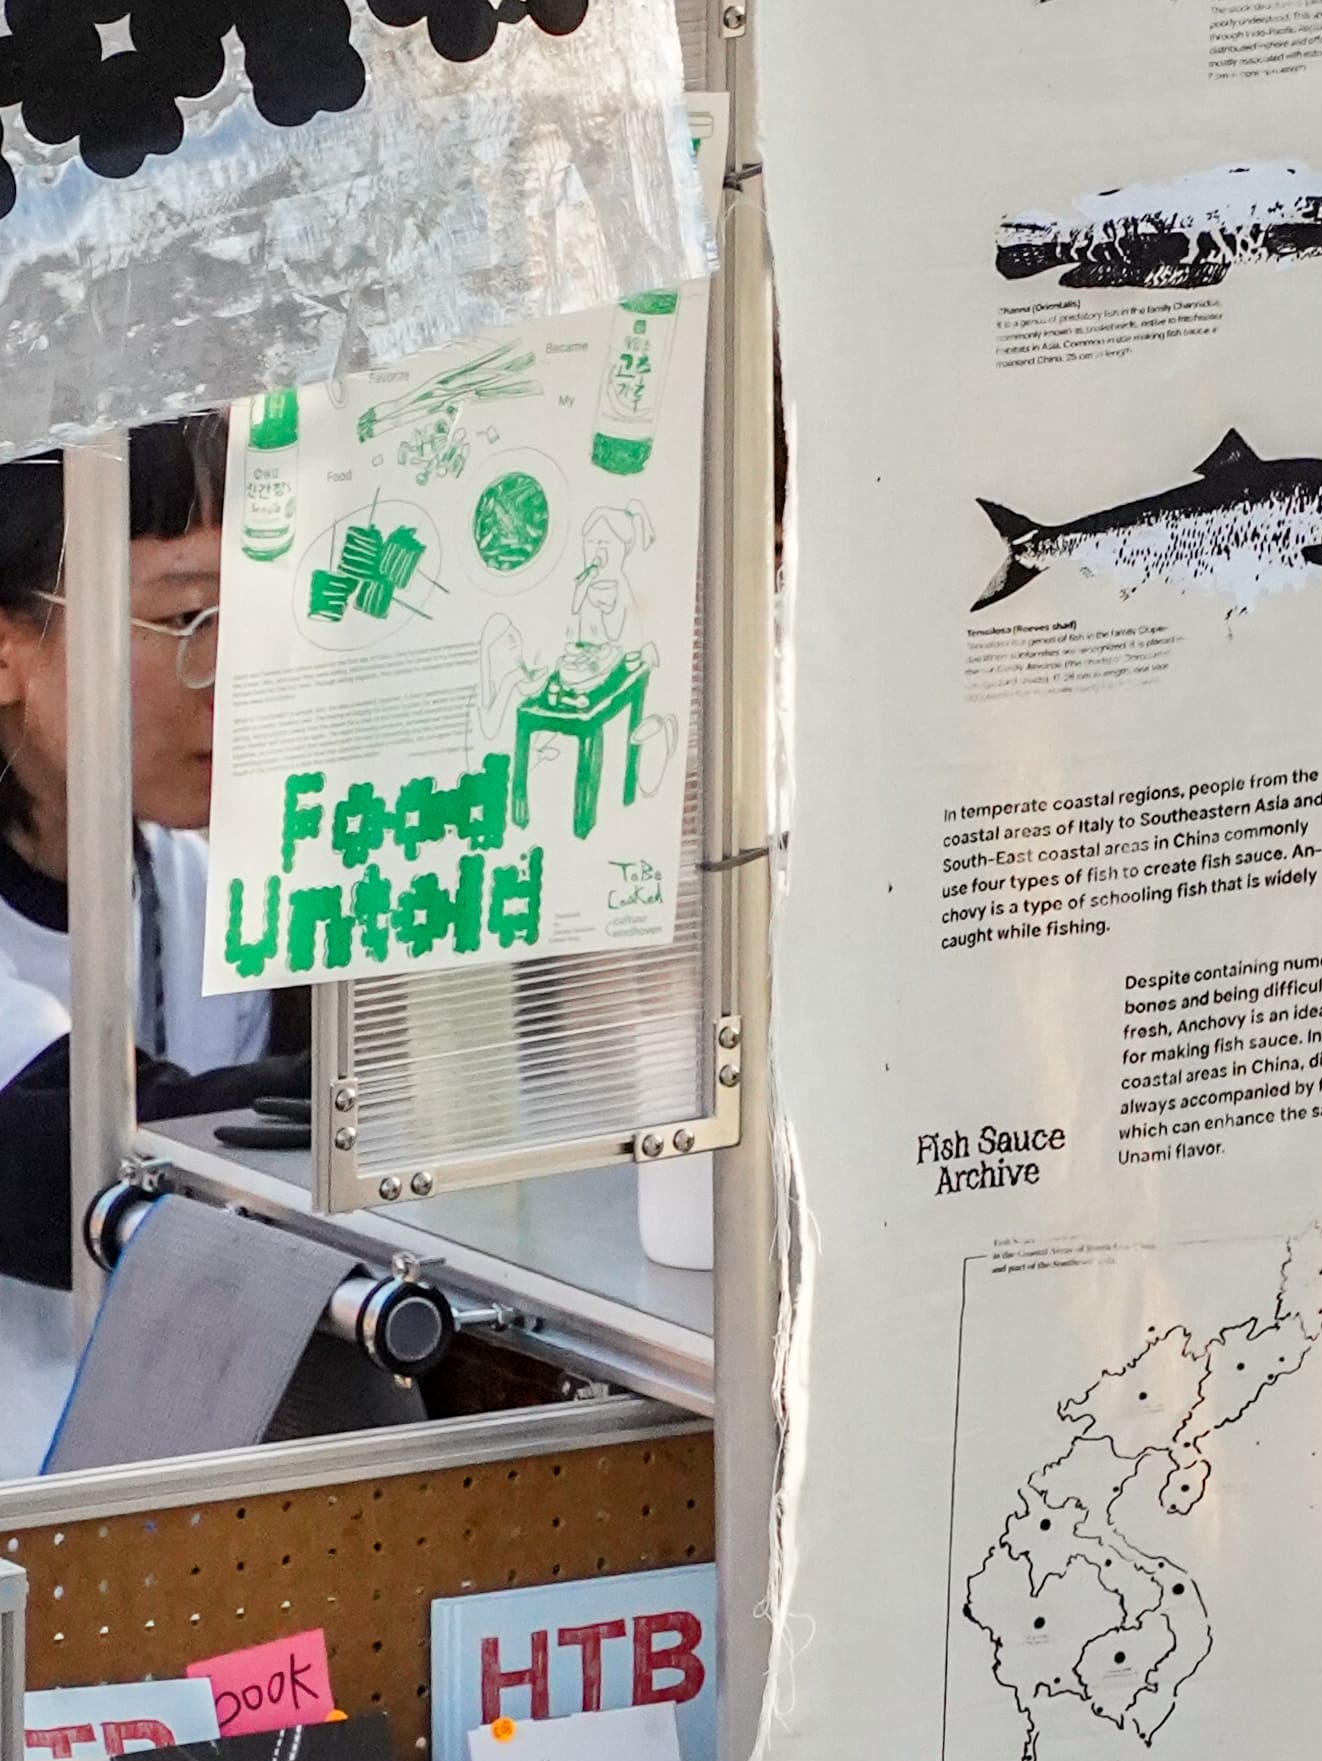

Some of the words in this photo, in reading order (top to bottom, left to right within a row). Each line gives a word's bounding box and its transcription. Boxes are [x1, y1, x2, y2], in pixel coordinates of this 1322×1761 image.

[546, 342, 589, 354] Became
[559, 395, 575, 407] My
[327, 471, 352, 481] Food
[282, 752, 511, 872] Food
[944, 806, 957, 824] In
[960, 797, 1048, 824] temperate
[1053, 790, 1114, 813] coastal
[1118, 781, 1186, 808] regions,
[1189, 776, 1245, 800] people
[1250, 770, 1288, 789] from
[1291, 767, 1319, 785] the
[226, 845, 544, 978] Untold
[941, 926, 993, 950] caught
[997, 922, 1041, 940] while
[1046, 916, 1111, 937] fishing.
[1125, 969, 1190, 991] Despite
[1194, 956, 1279, 984] containing
[917, 1129, 970, 1165] Fish
[978, 1125, 1066, 1155] Sauce
[935, 1158, 1040, 1196] Archive
[481, 1611, 705, 1725] HTB
